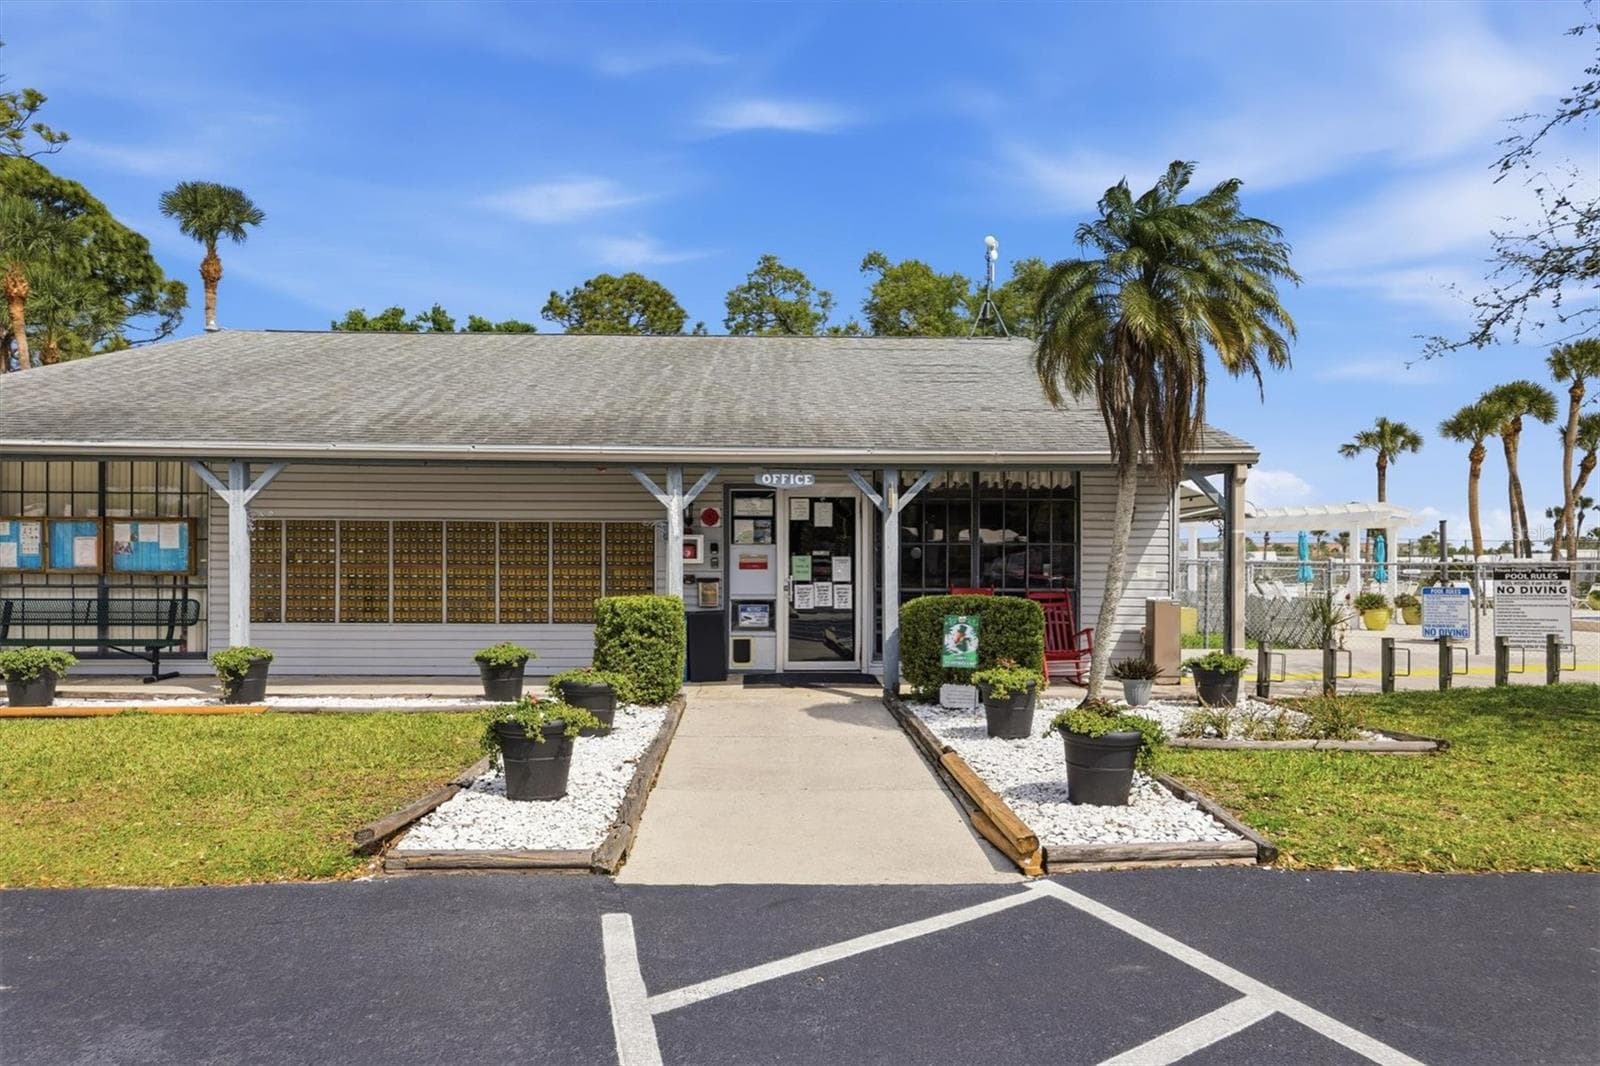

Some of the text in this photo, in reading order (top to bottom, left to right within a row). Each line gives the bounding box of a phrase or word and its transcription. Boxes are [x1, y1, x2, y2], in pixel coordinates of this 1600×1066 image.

[761, 473, 812, 485] OFFICE
[1496, 586, 1568, 594] NO DIVING
[1424, 628, 1468, 637] NO DIVING
